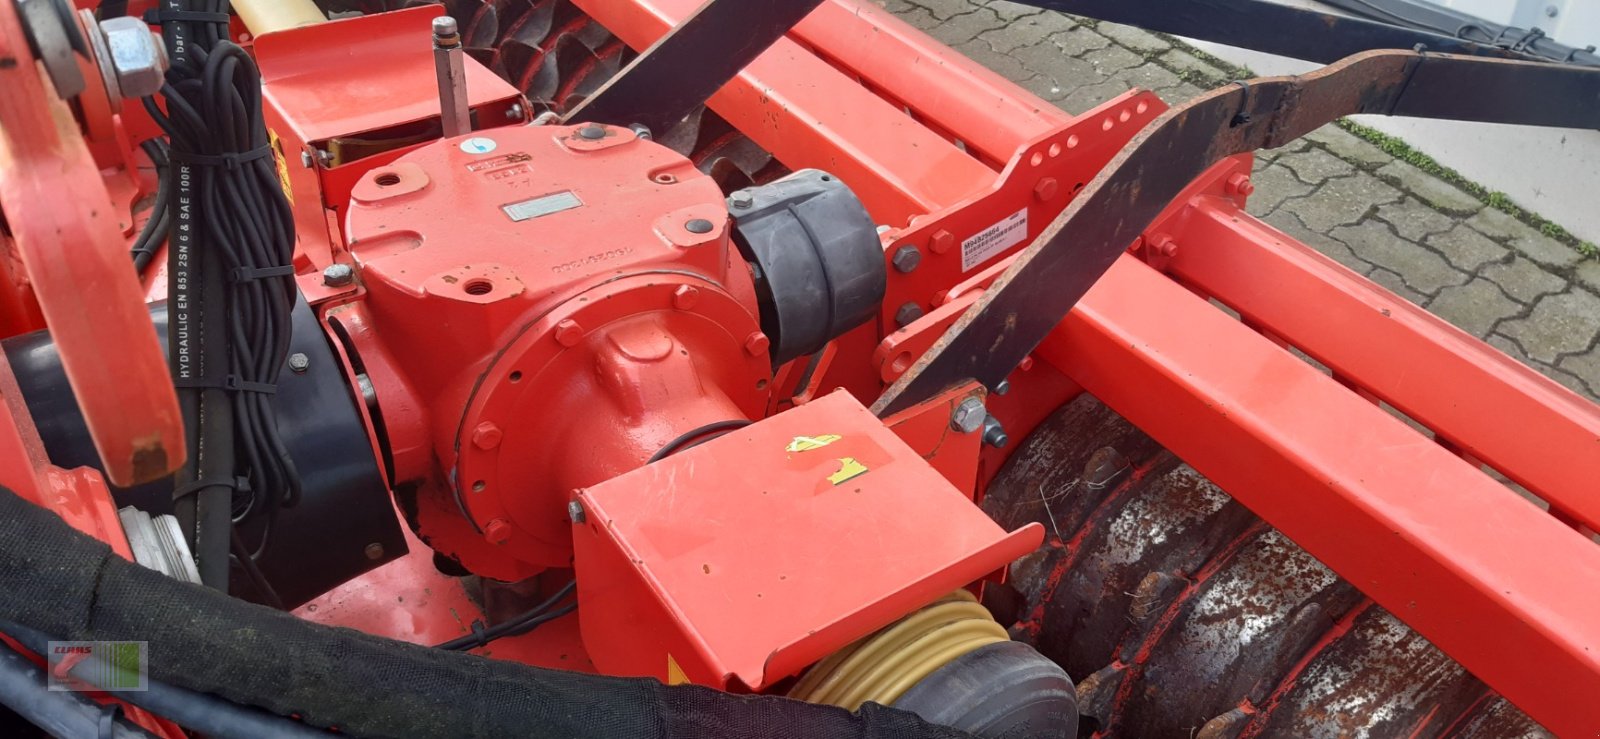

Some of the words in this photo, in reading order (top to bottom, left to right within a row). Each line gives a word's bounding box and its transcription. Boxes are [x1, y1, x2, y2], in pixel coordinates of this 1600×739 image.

[175, 35, 185, 53] bar
[180, 164, 190, 193] 100R
[180, 197, 190, 220] SAE
[179, 224, 189, 232] &
[178, 245, 188, 267] 2SN
[177, 271, 188, 290] 853
[177, 294, 188, 309] EN
[178, 313, 190, 378] HYDRAULIC
